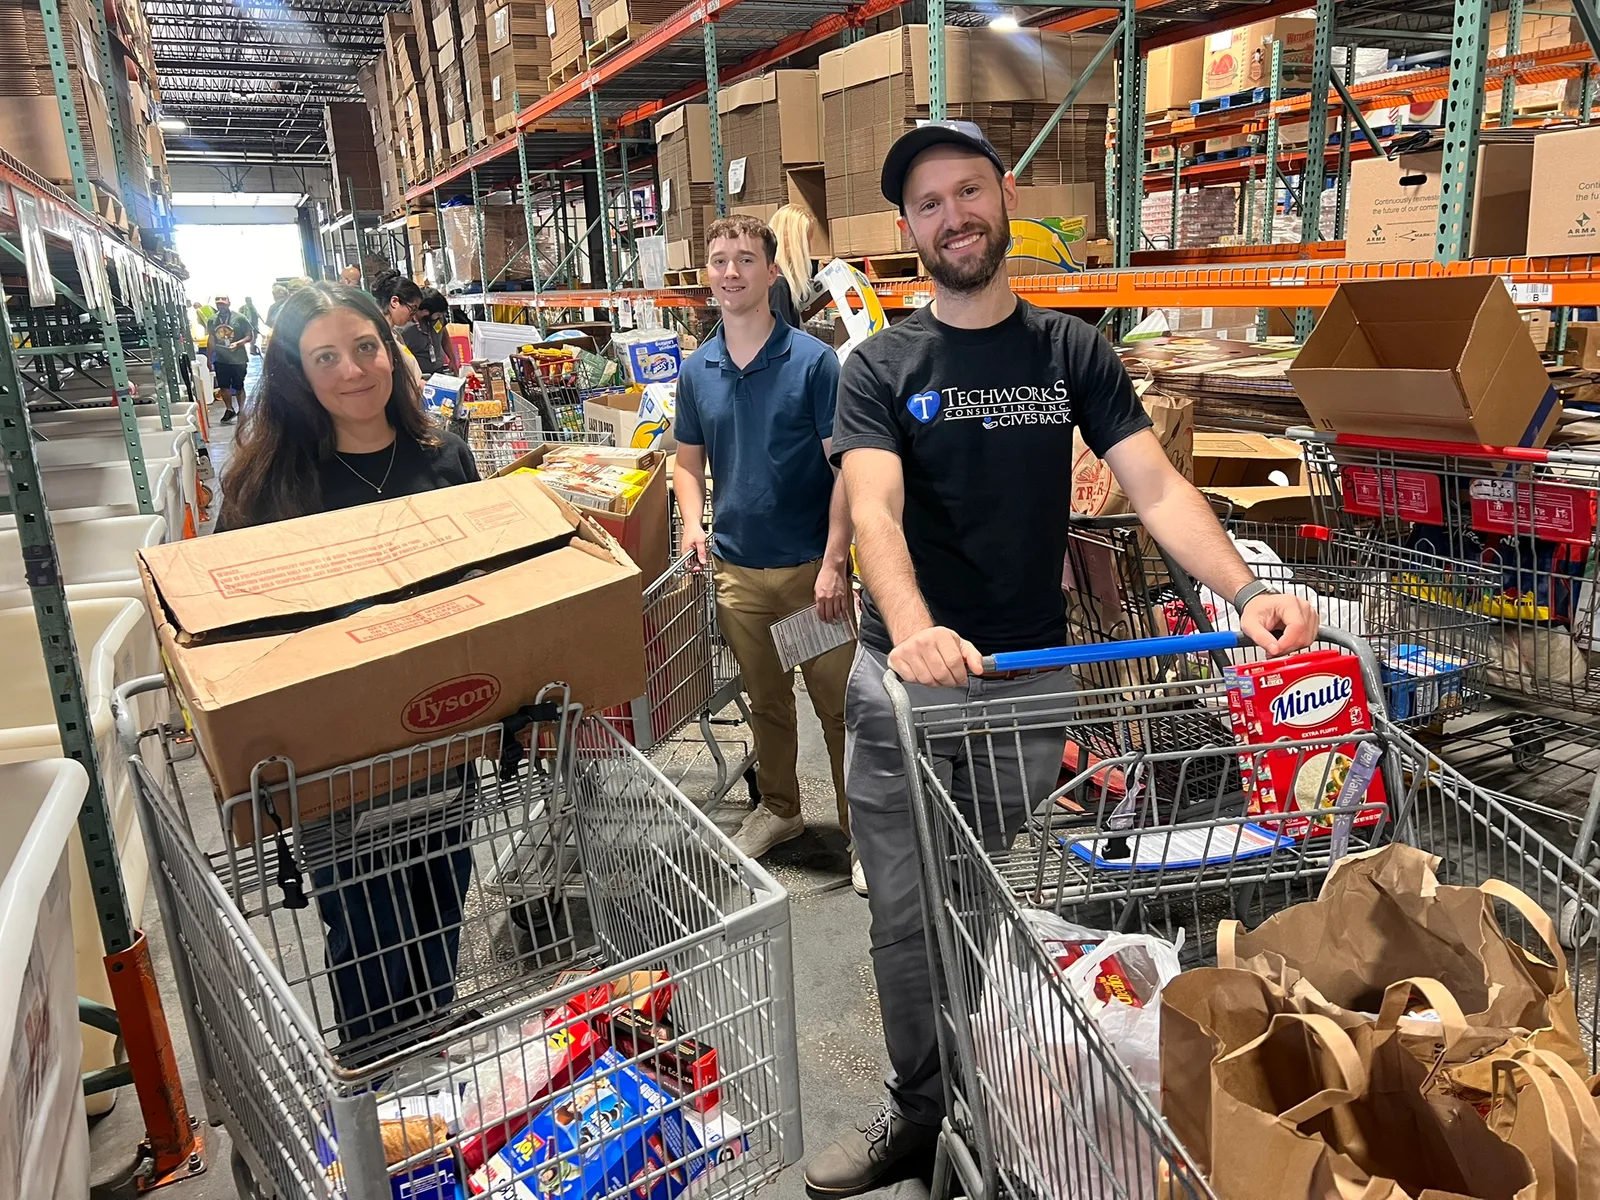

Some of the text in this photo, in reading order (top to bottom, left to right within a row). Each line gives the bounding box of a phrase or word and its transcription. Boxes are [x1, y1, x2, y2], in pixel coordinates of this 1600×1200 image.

[1374, 196, 1412, 206] Continuously
[1591, 192, 1600, 201] fu
[1382, 206, 1400, 214] future
[1567, 227, 1596, 235] ARMA
[1511, 284, 1518, 292] A
[1532, 294, 1540, 302] B
[914, 396, 933, 420] T
[945, 402, 1069, 418] CONSULTING INC.
[999, 412, 1071, 427] GIVES BACK
[1259, 676, 1268, 688] 1
[411, 683, 497, 724] Tyson
[1271, 677, 1352, 725] Minute
[1301, 726, 1338, 738] EXTRA FLUFFY
[299, 794, 352, 816] DISTRIBTED
